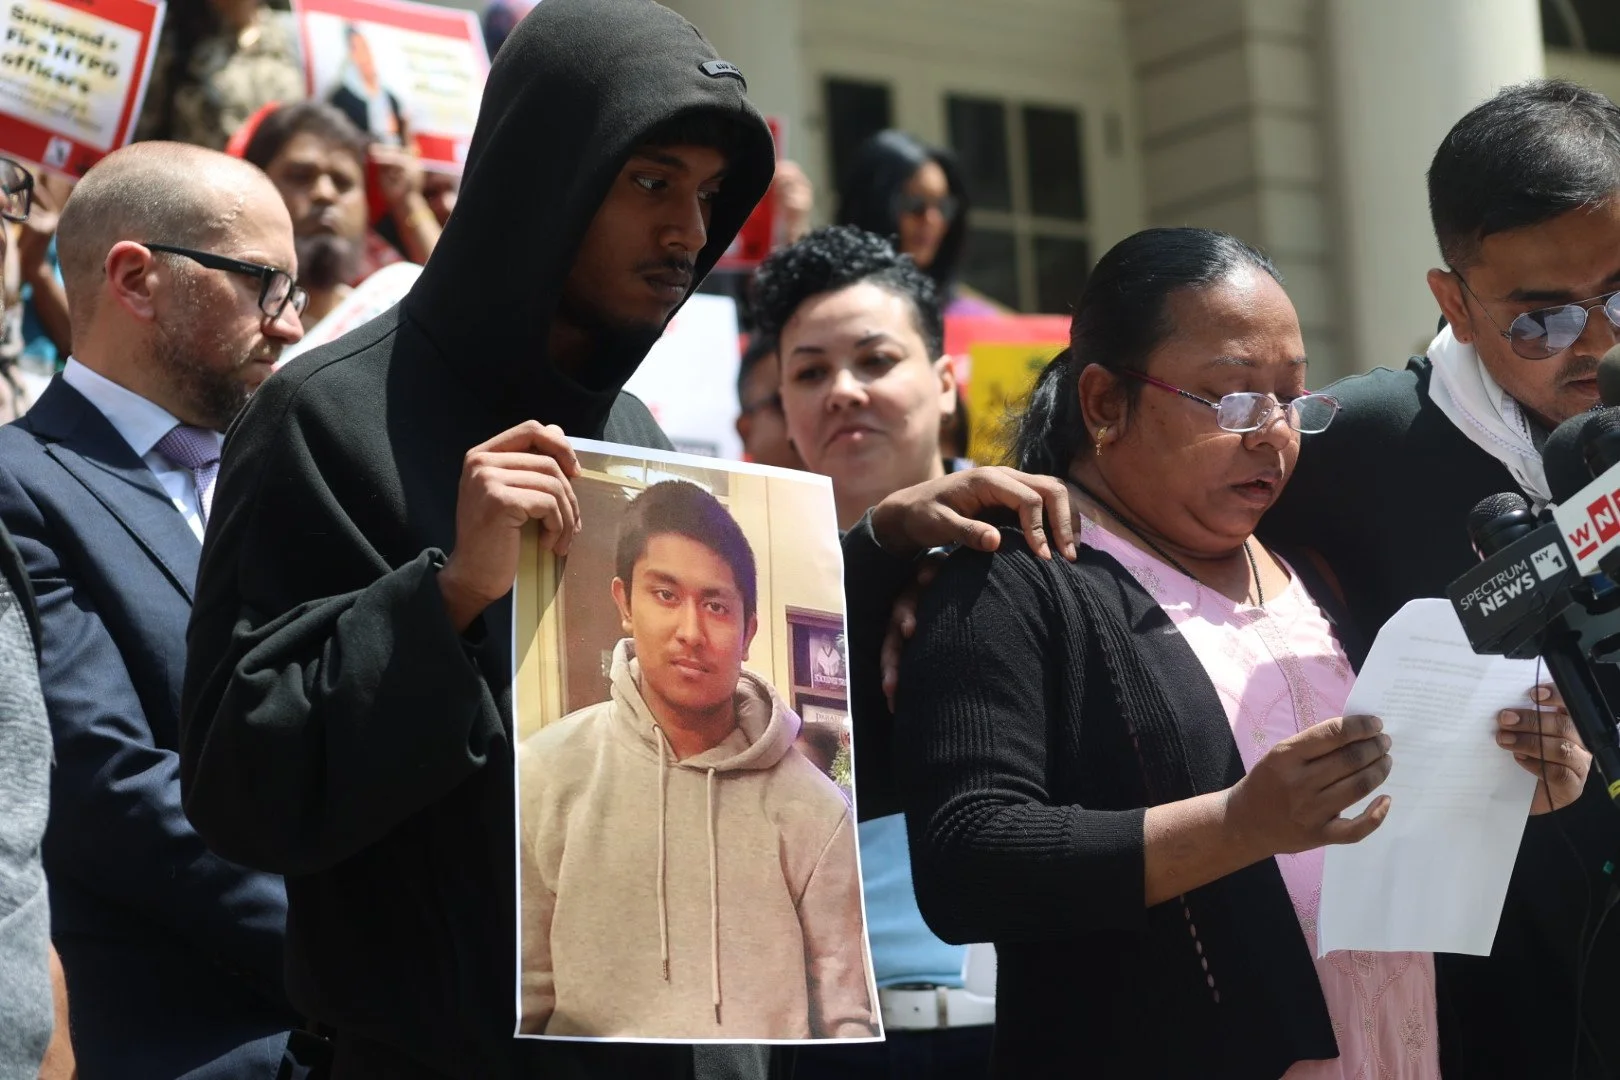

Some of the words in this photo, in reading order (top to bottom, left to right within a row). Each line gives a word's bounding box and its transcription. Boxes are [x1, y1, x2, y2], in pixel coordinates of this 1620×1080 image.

[54, 44, 119, 78] NYPD
[1568, 494, 1620, 547] WN
[1534, 549, 1549, 563] NY
[1552, 555, 1563, 567] 1
[1460, 559, 1528, 611] SPECTRUM
[1479, 572, 1535, 617] NEWS
